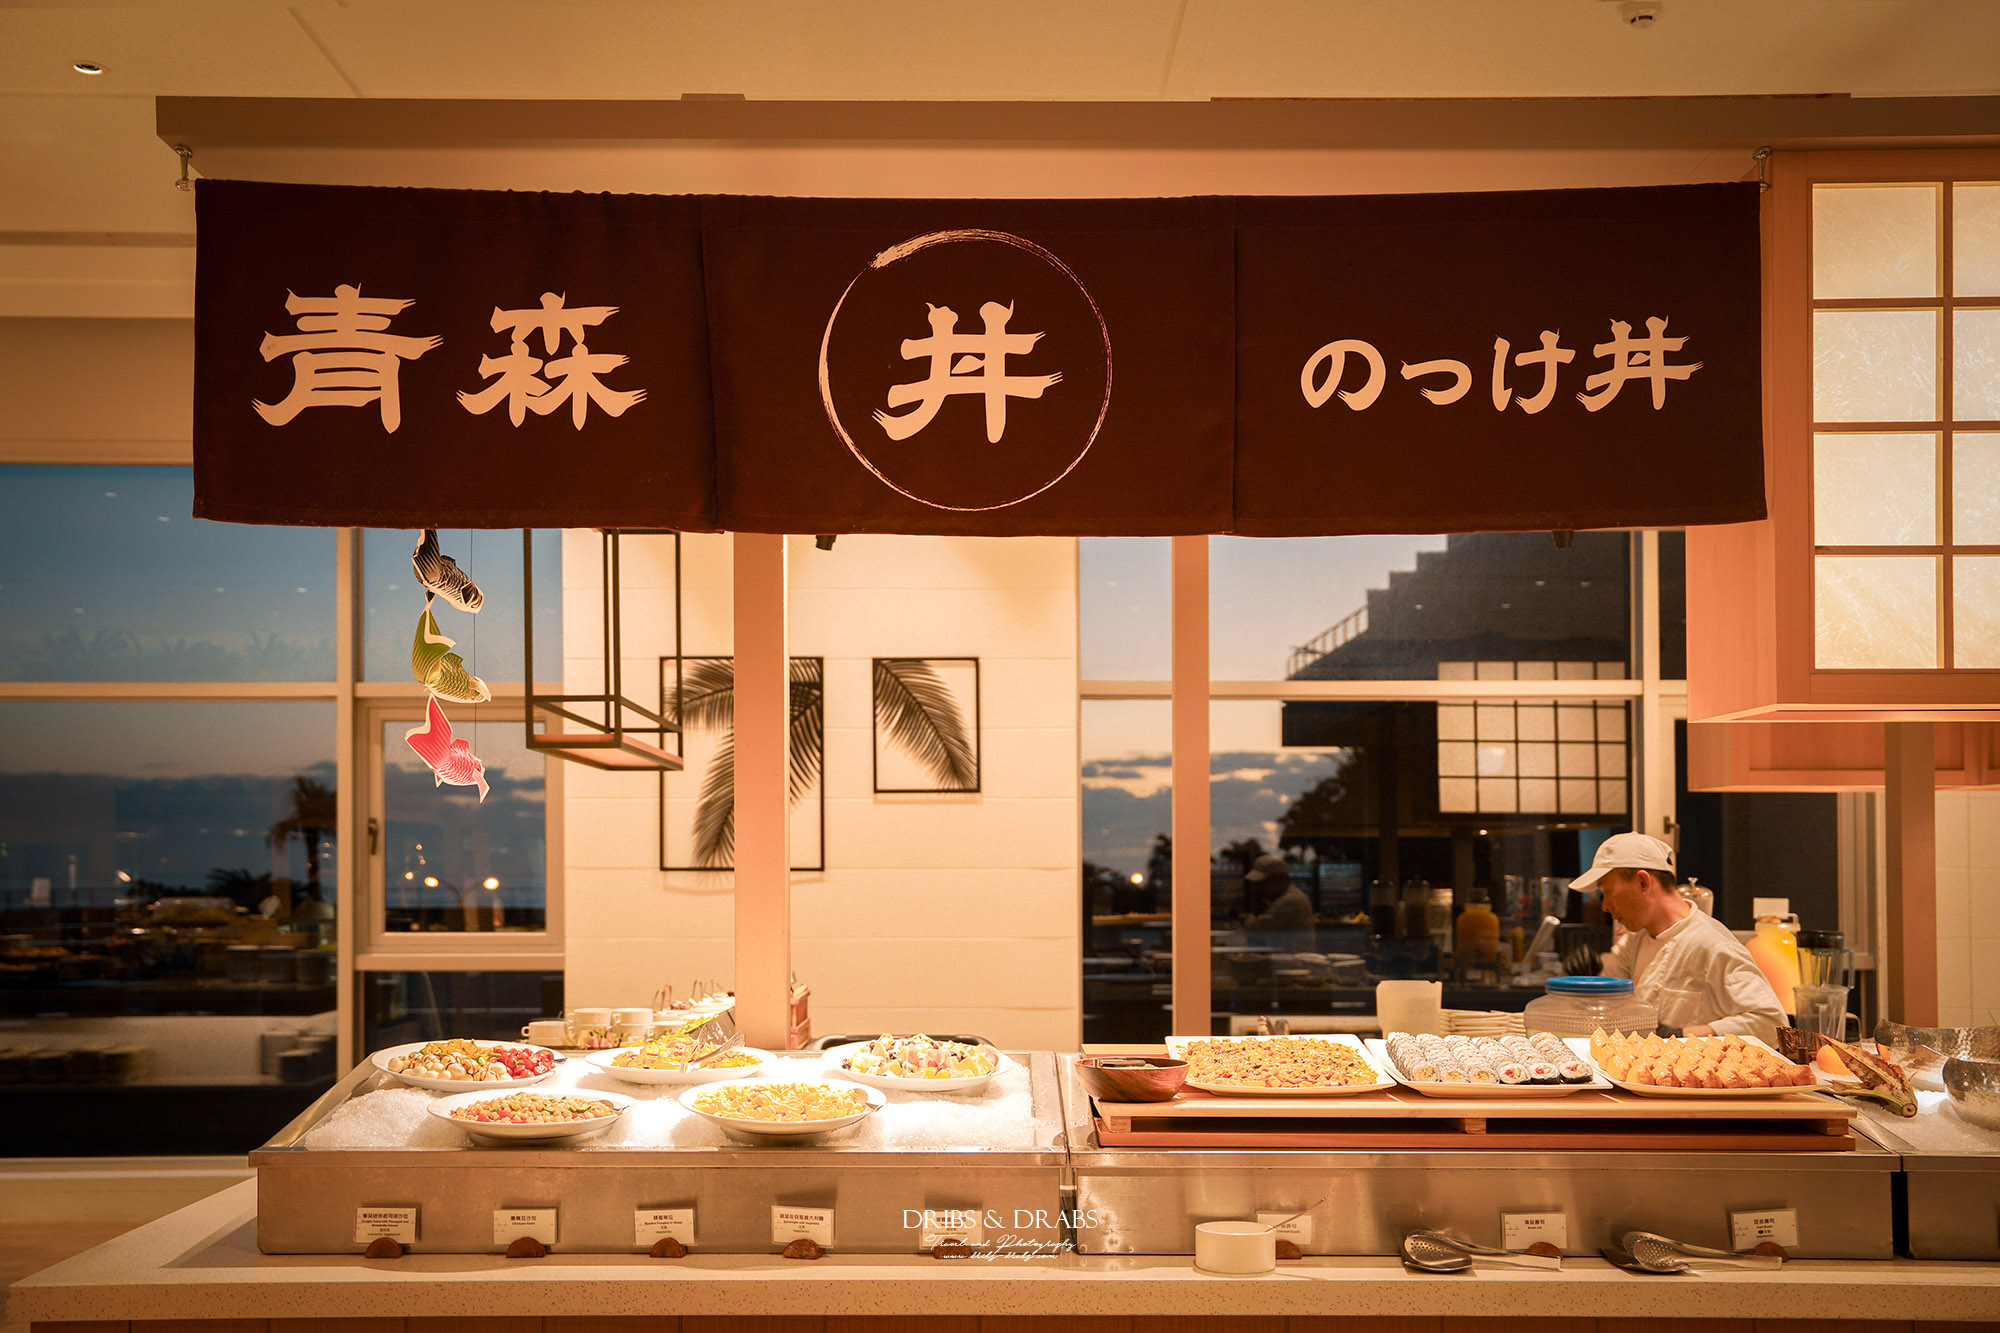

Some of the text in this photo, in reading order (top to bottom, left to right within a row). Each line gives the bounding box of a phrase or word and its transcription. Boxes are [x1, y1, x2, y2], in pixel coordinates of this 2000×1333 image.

[252, 284, 648, 433] 青森
[1300, 316, 1703, 414] のっけ丼
